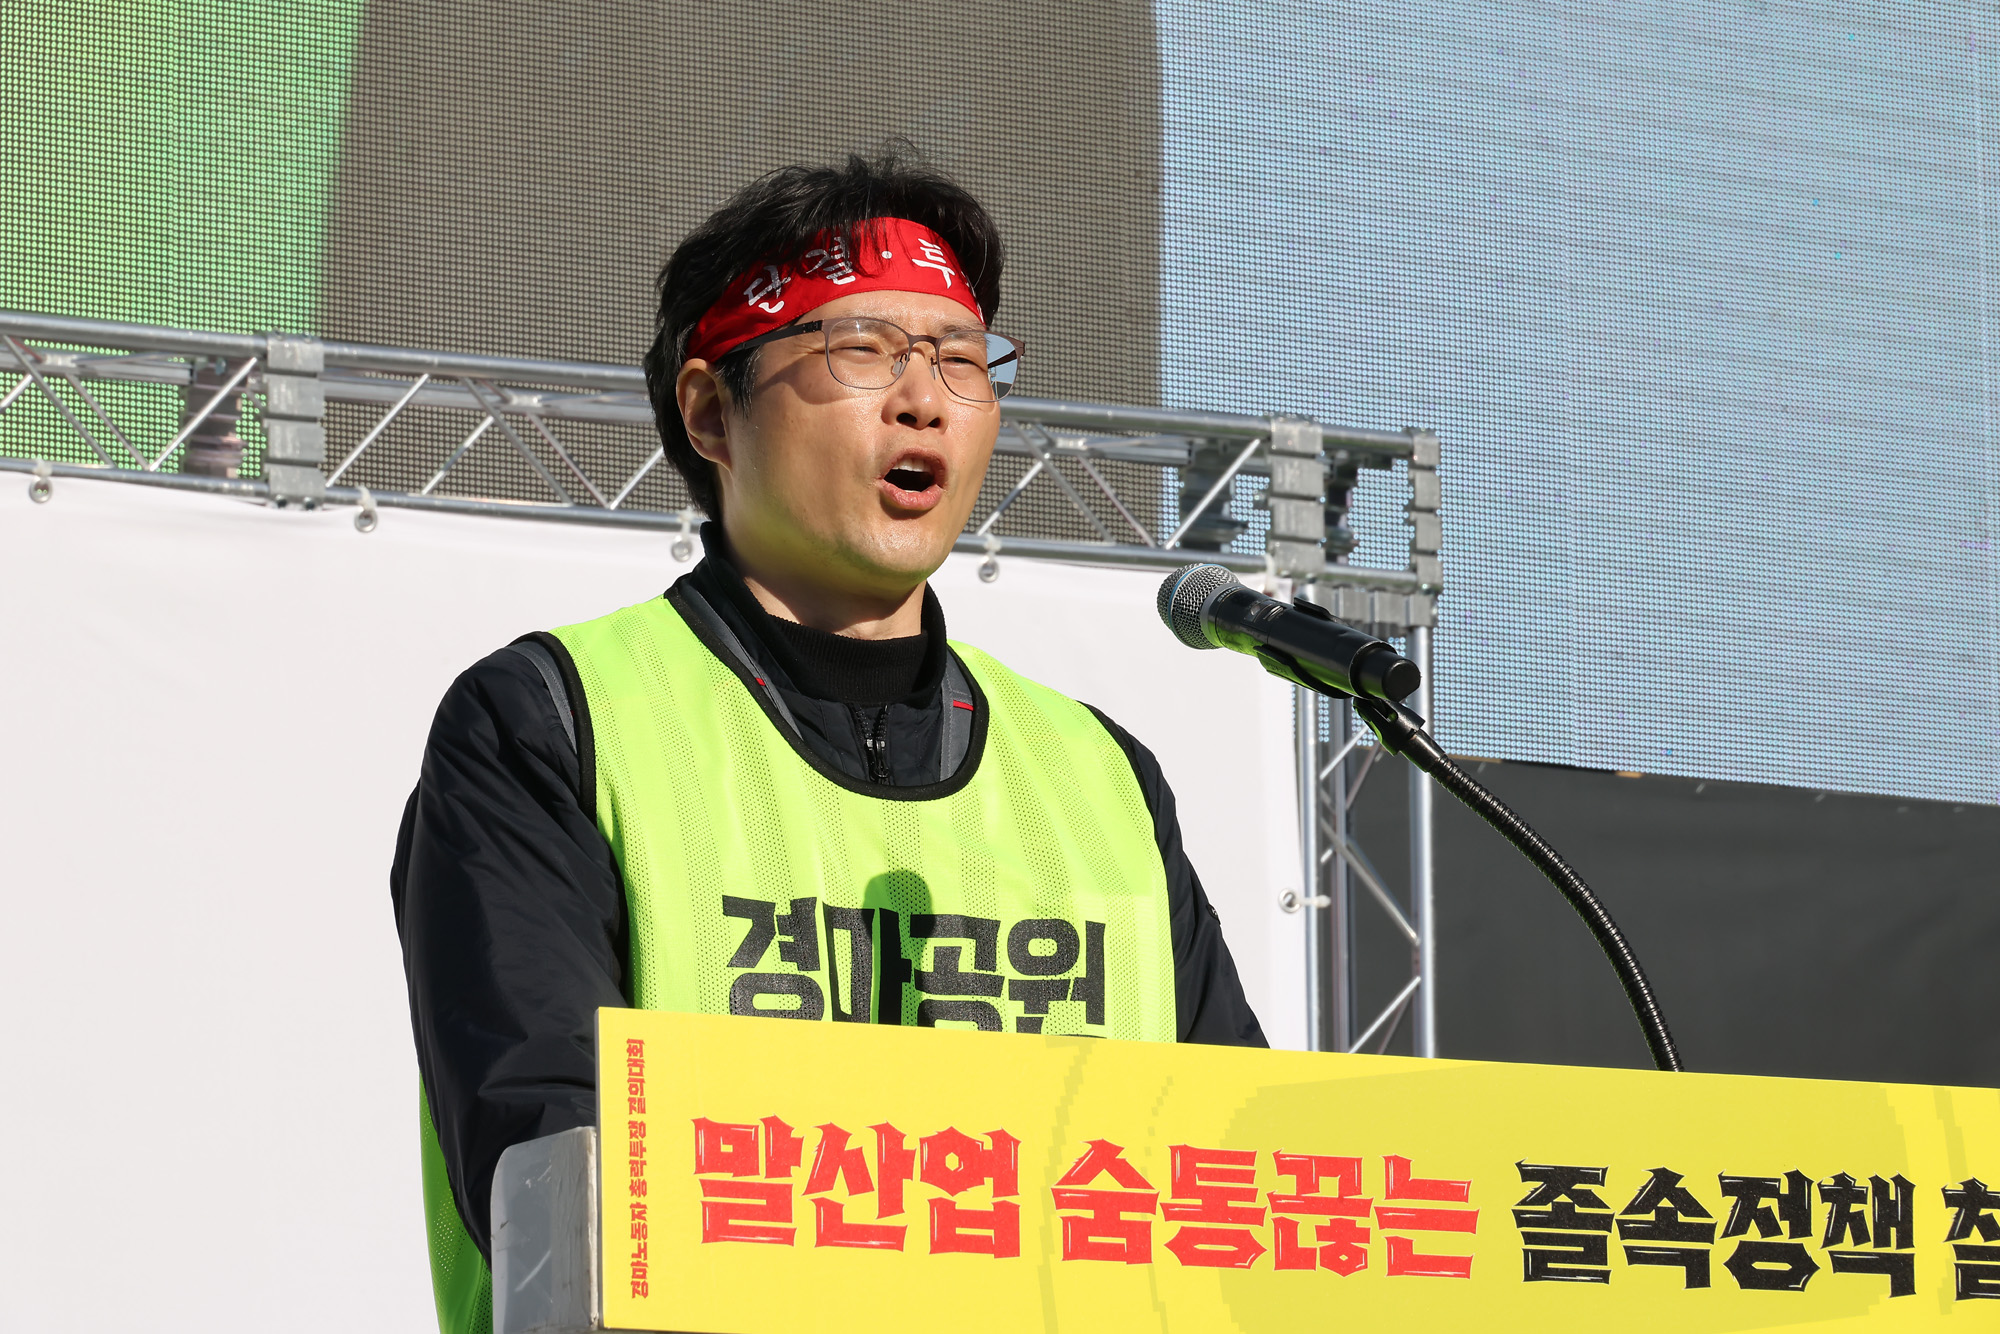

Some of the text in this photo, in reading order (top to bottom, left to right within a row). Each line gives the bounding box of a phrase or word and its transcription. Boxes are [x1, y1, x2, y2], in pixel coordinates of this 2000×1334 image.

[721, 895, 1107, 1039] 경마공원
[626, 1038, 649, 1299] 경마노동자 총력투쟁 결의대회
[692, 1114, 1022, 1259] 말산업
[1050, 1138, 1481, 1279] 숨통끊는
[1511, 1159, 1917, 1298] 졸속정책
